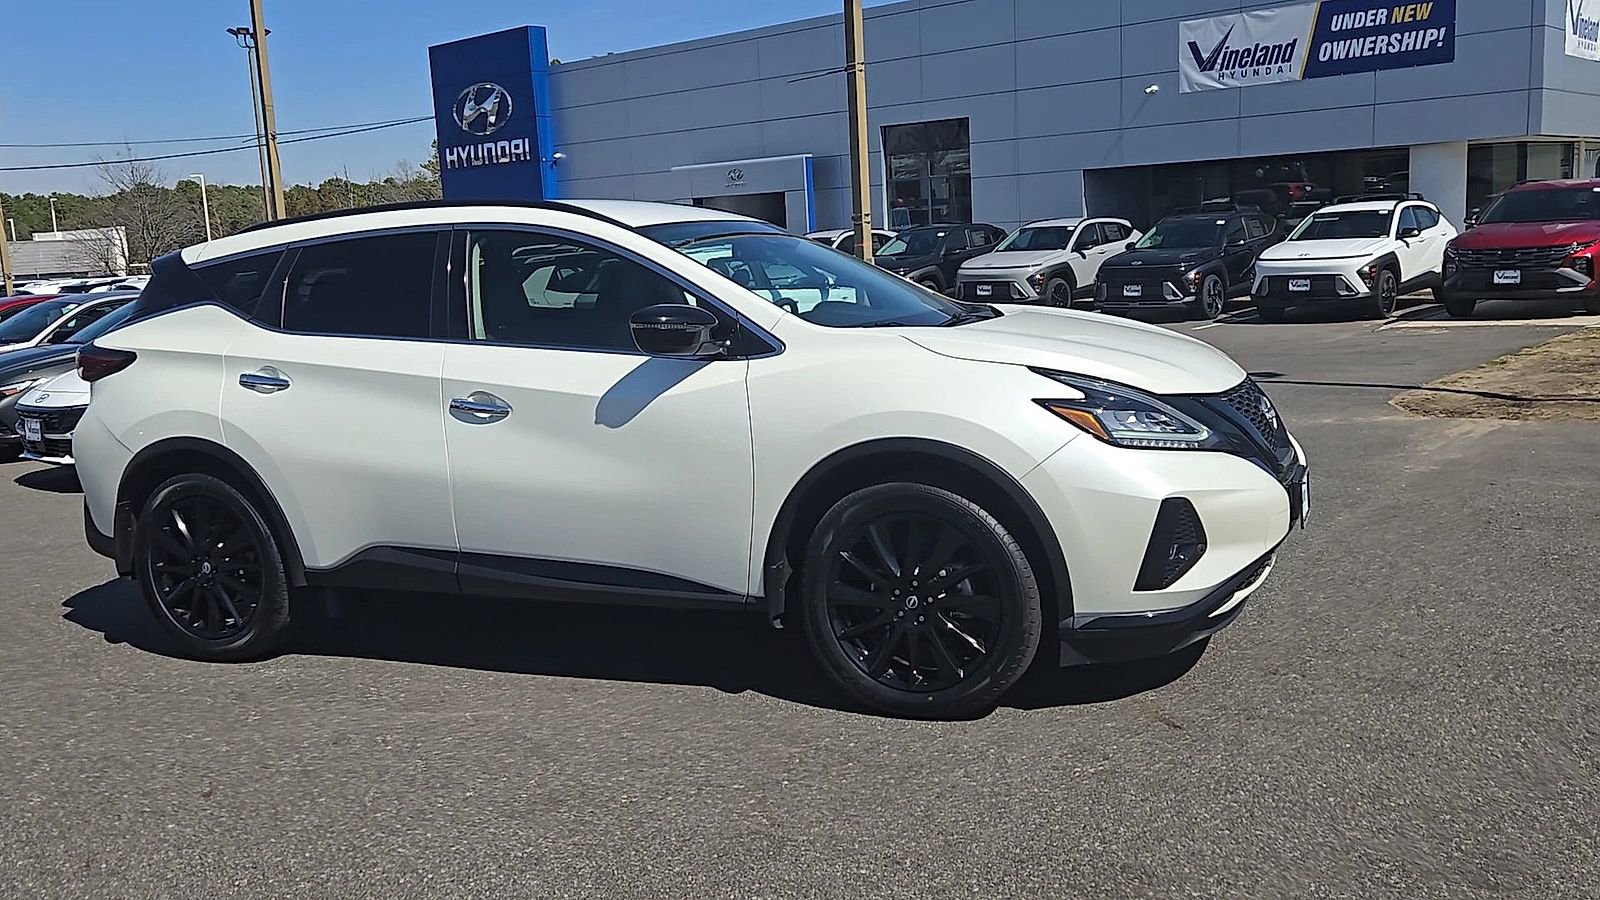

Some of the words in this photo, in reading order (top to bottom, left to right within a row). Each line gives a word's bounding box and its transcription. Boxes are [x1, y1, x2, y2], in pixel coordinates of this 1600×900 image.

[1331, 8, 1388, 32] UNDER
[1390, 1, 1434, 24] NEW
[1187, 23, 1299, 72] Vineland
[1318, 26, 1447, 62] OWNERSHIP!
[1218, 63, 1293, 81] HYUNDAI
[445, 137, 531, 169] HYUNDAI
